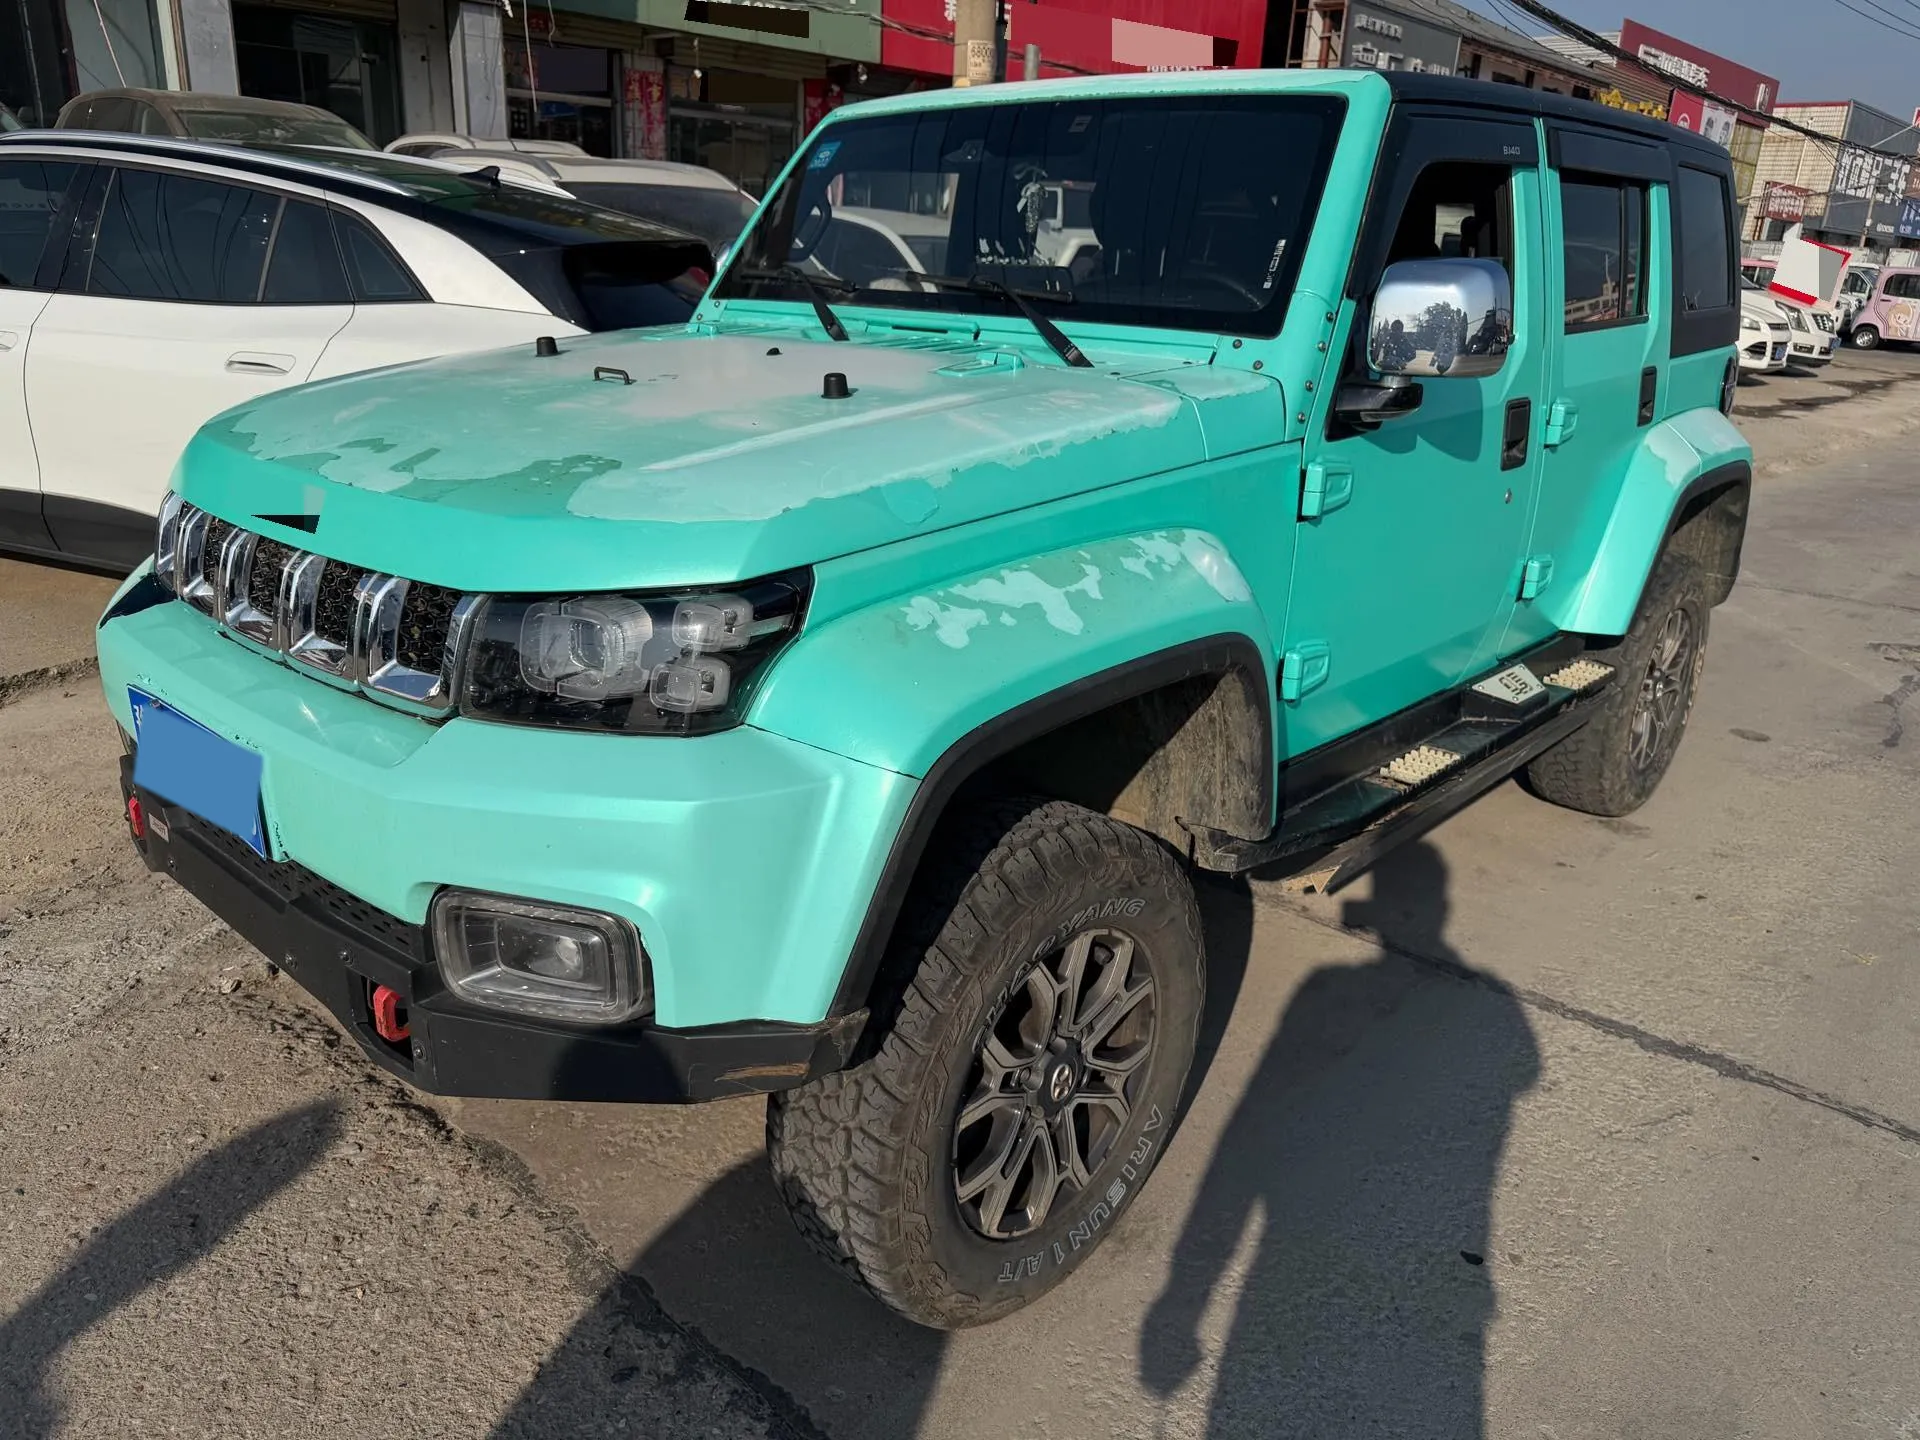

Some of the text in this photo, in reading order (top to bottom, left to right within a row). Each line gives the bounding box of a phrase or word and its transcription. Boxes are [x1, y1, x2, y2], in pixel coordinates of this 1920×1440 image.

[1503, 145, 1521, 155] BJ40
[997, 1103, 1163, 1282] ARISUN 1 A/T
